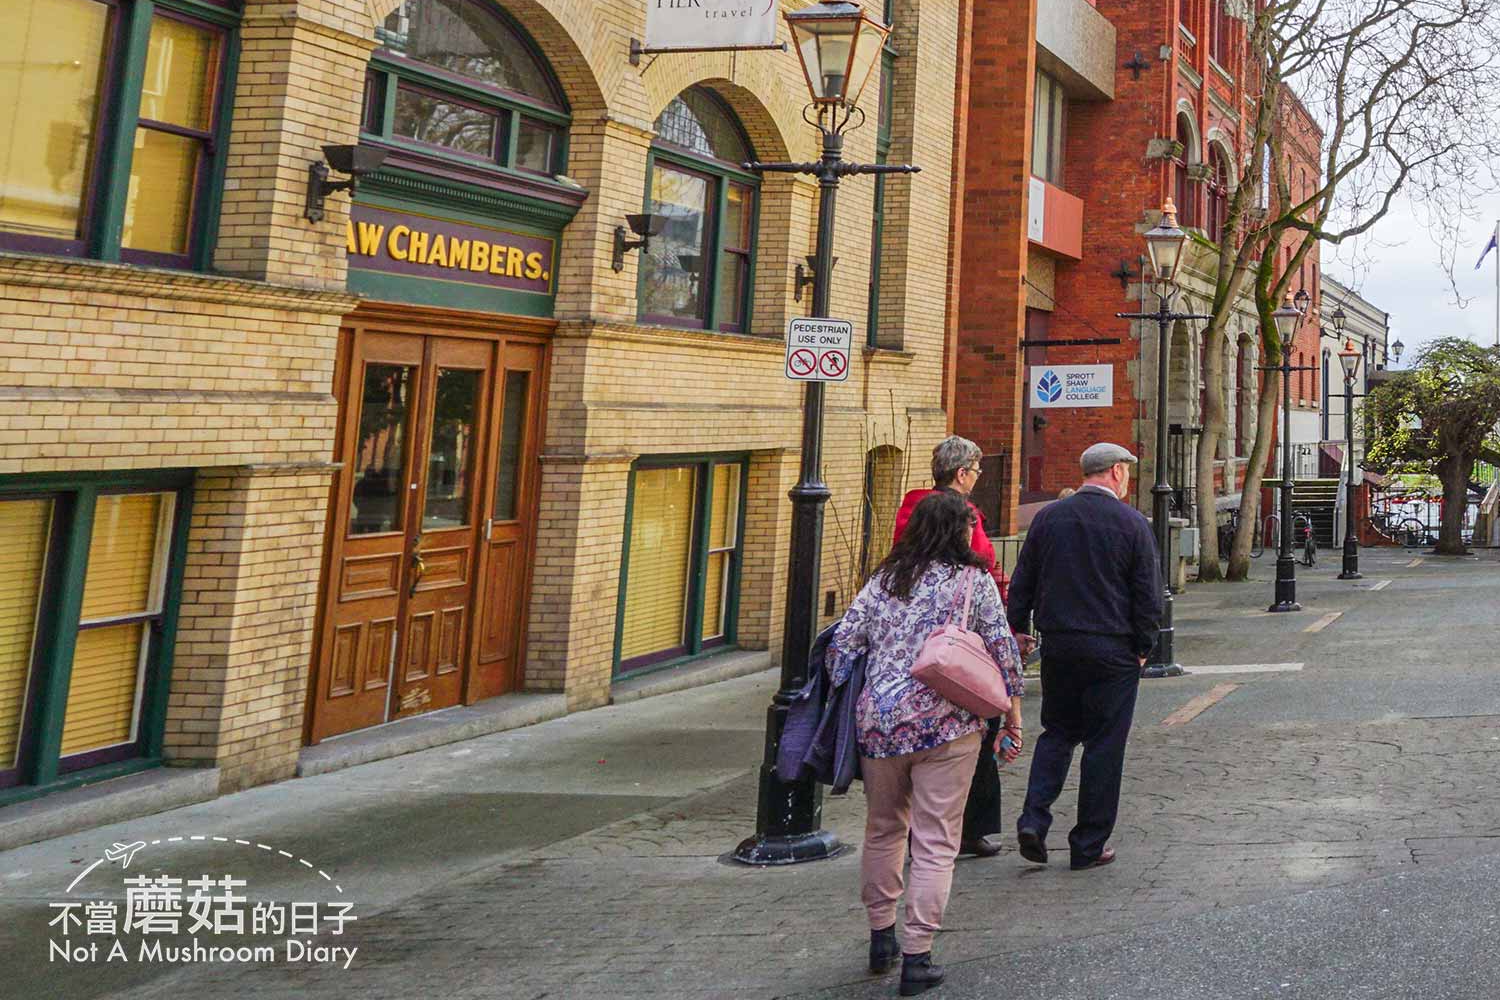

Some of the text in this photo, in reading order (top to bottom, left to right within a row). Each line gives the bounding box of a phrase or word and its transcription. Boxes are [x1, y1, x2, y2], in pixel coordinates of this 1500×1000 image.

[705, 6, 753, 18] travel
[346, 219, 549, 281] AW CHAMBERS.
[793, 324, 849, 334] PEDESTRIAN
[798, 335, 842, 345] USE ONLY
[1066, 372, 1095, 380] SPROTT
[1065, 393, 1100, 401] COLLEGE
